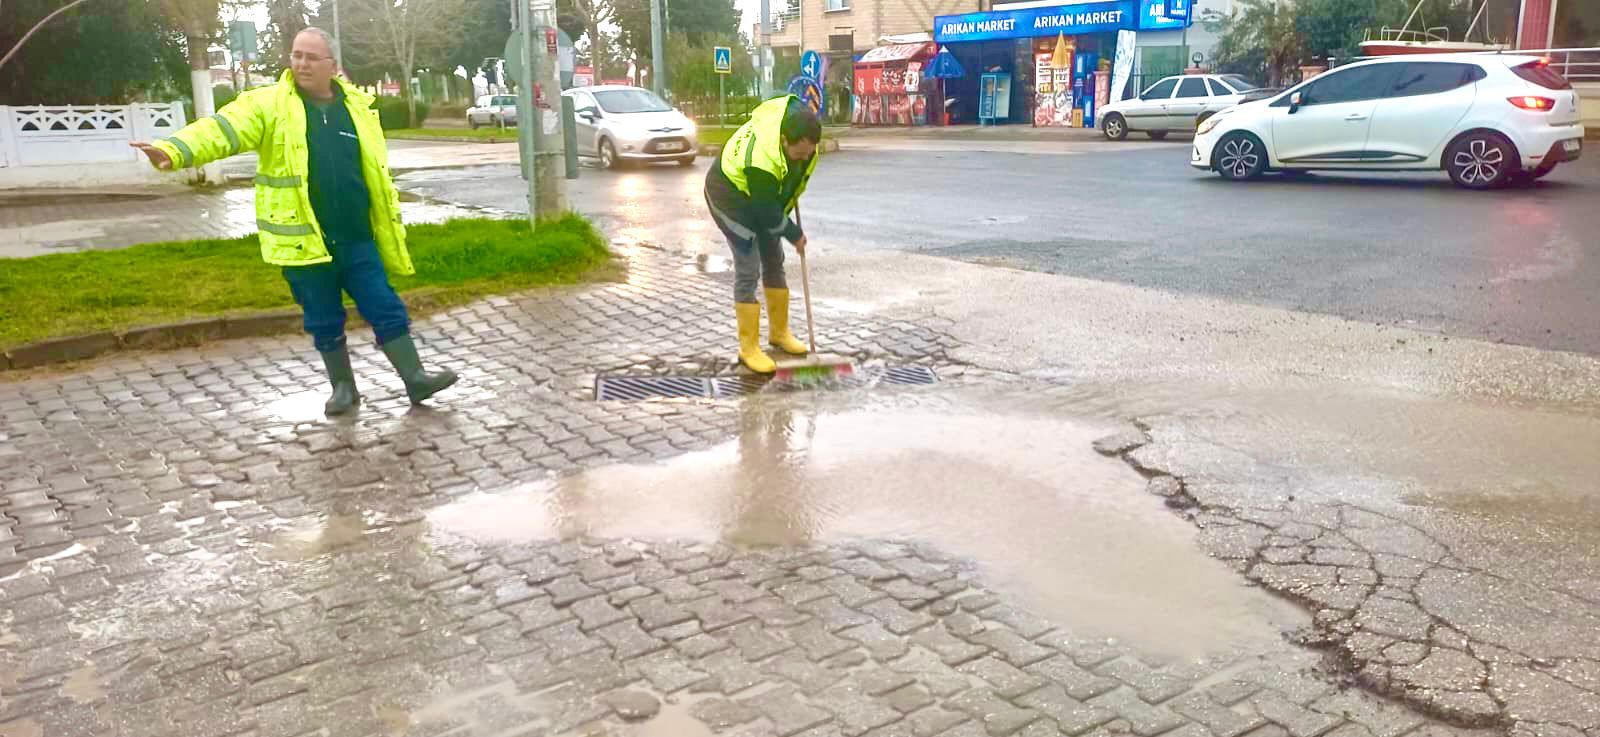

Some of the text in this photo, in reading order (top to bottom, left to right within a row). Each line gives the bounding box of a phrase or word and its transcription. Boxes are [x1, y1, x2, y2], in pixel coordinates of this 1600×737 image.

[941, 18, 1016, 36] ARIKAN MARKET
[1034, 11, 1123, 28] ARIKAN MARKET
